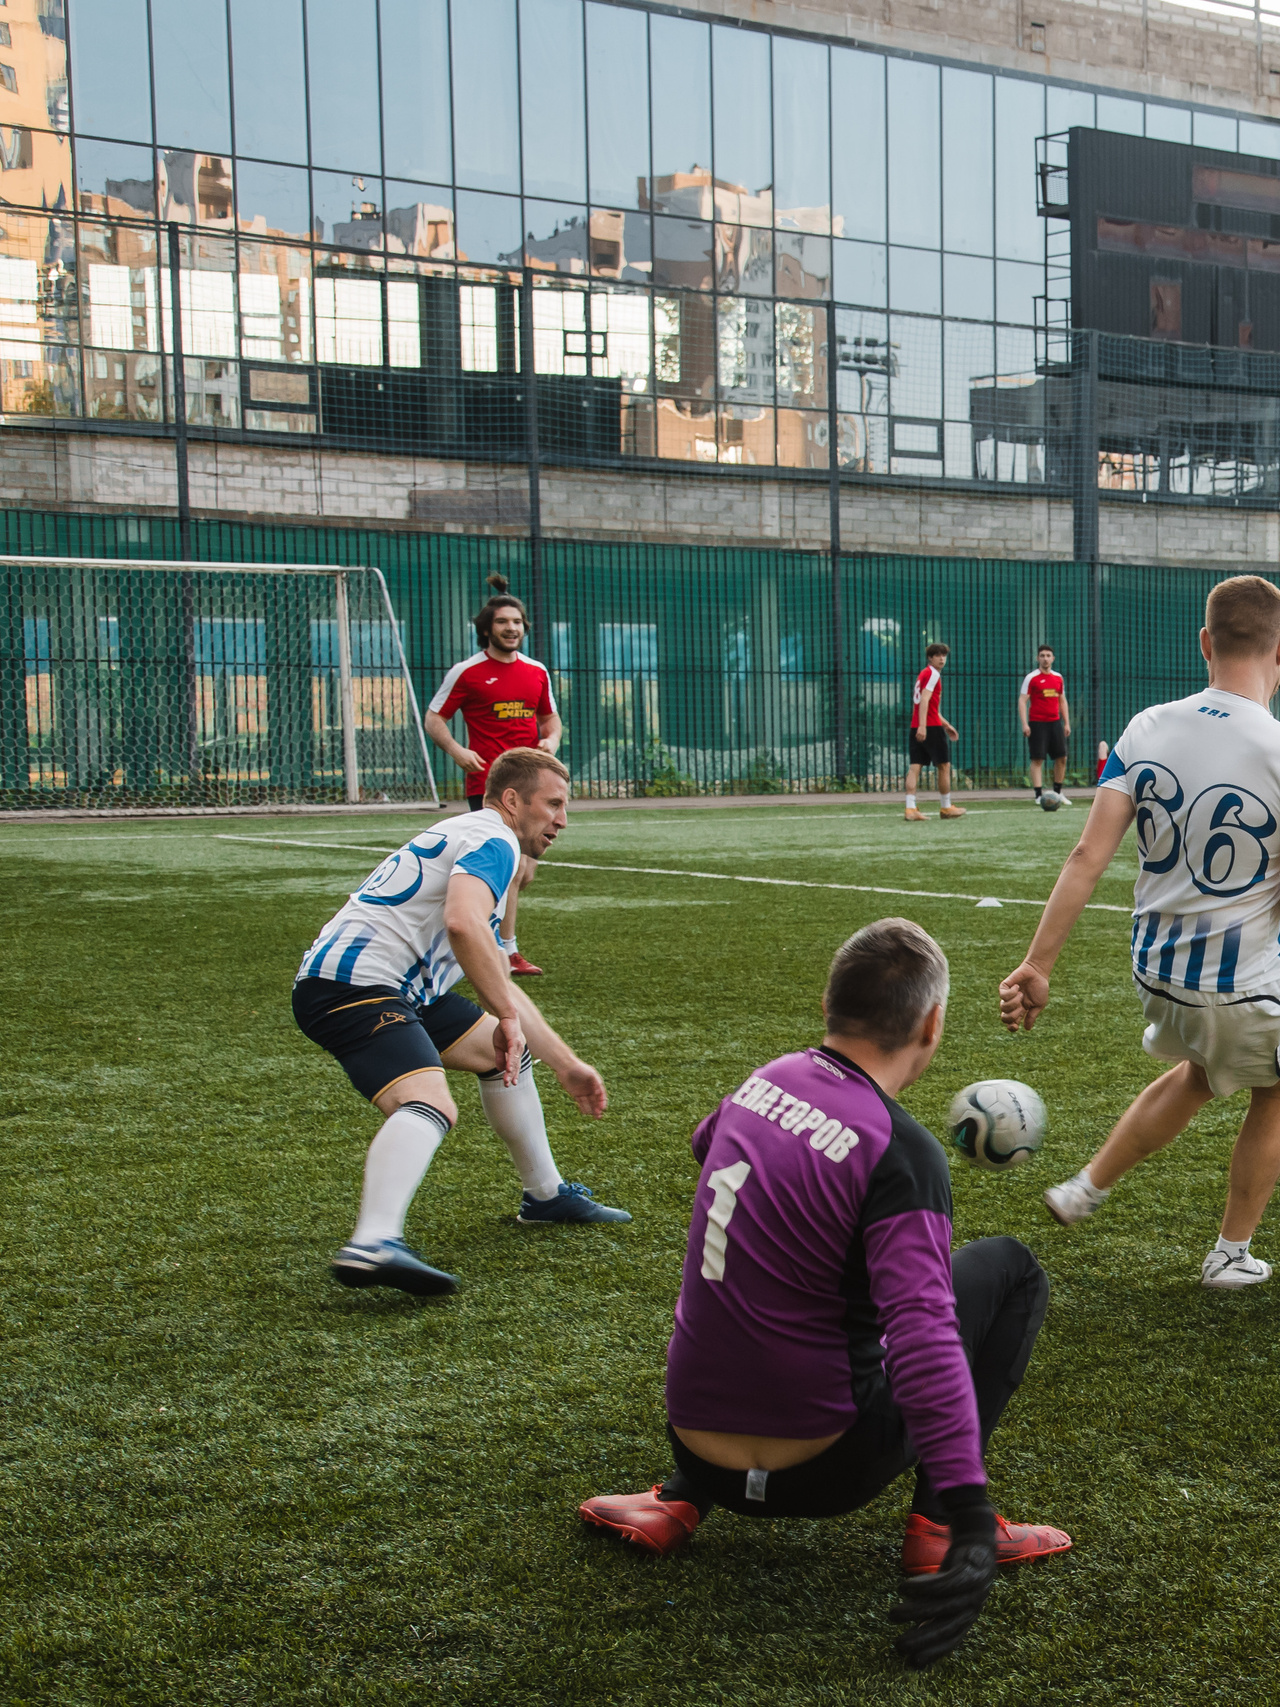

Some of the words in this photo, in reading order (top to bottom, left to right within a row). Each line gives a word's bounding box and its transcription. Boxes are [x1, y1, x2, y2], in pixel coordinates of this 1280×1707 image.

[1125, 760, 1277, 898] 66
[731, 1076, 860, 1164] ЕНАТОРОВ
[701, 1160, 752, 1283] 1
